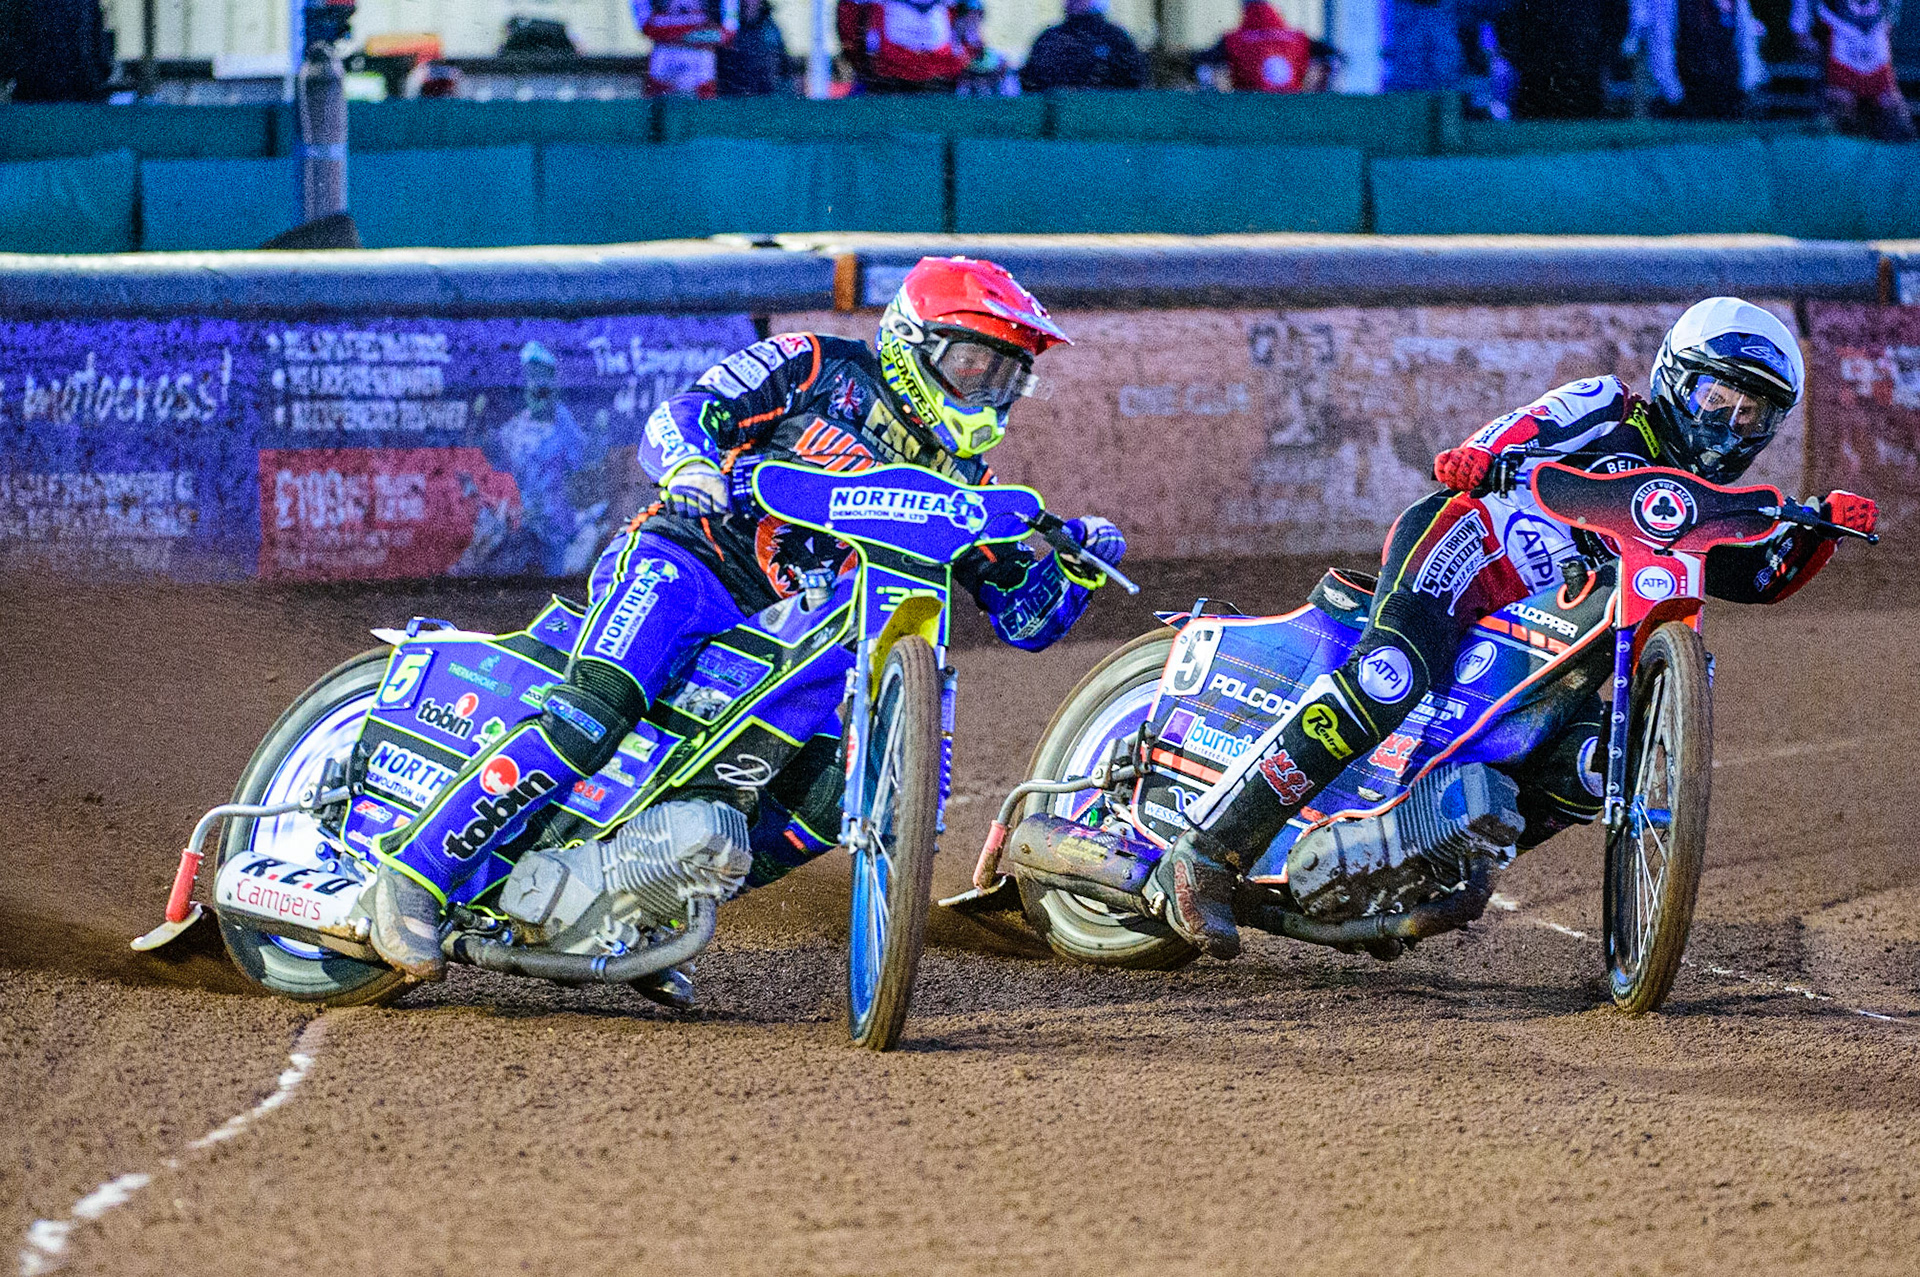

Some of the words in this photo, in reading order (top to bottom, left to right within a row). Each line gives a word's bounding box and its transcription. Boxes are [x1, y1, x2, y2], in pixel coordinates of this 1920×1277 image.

[832, 510, 889, 518] DEMOLITION
[1515, 529, 1557, 587] ATPI
[1641, 578, 1669, 589] ATPI
[1503, 602, 1579, 639] POLCOPPER
[381, 653, 431, 704] 5
[1367, 658, 1403, 690] ATPI
[418, 700, 472, 738] tobin
[1190, 720, 1252, 758] burnsi
[415, 792, 429, 804] UK
[444, 771, 557, 860] tobin
[236, 878, 322, 920] Campers
